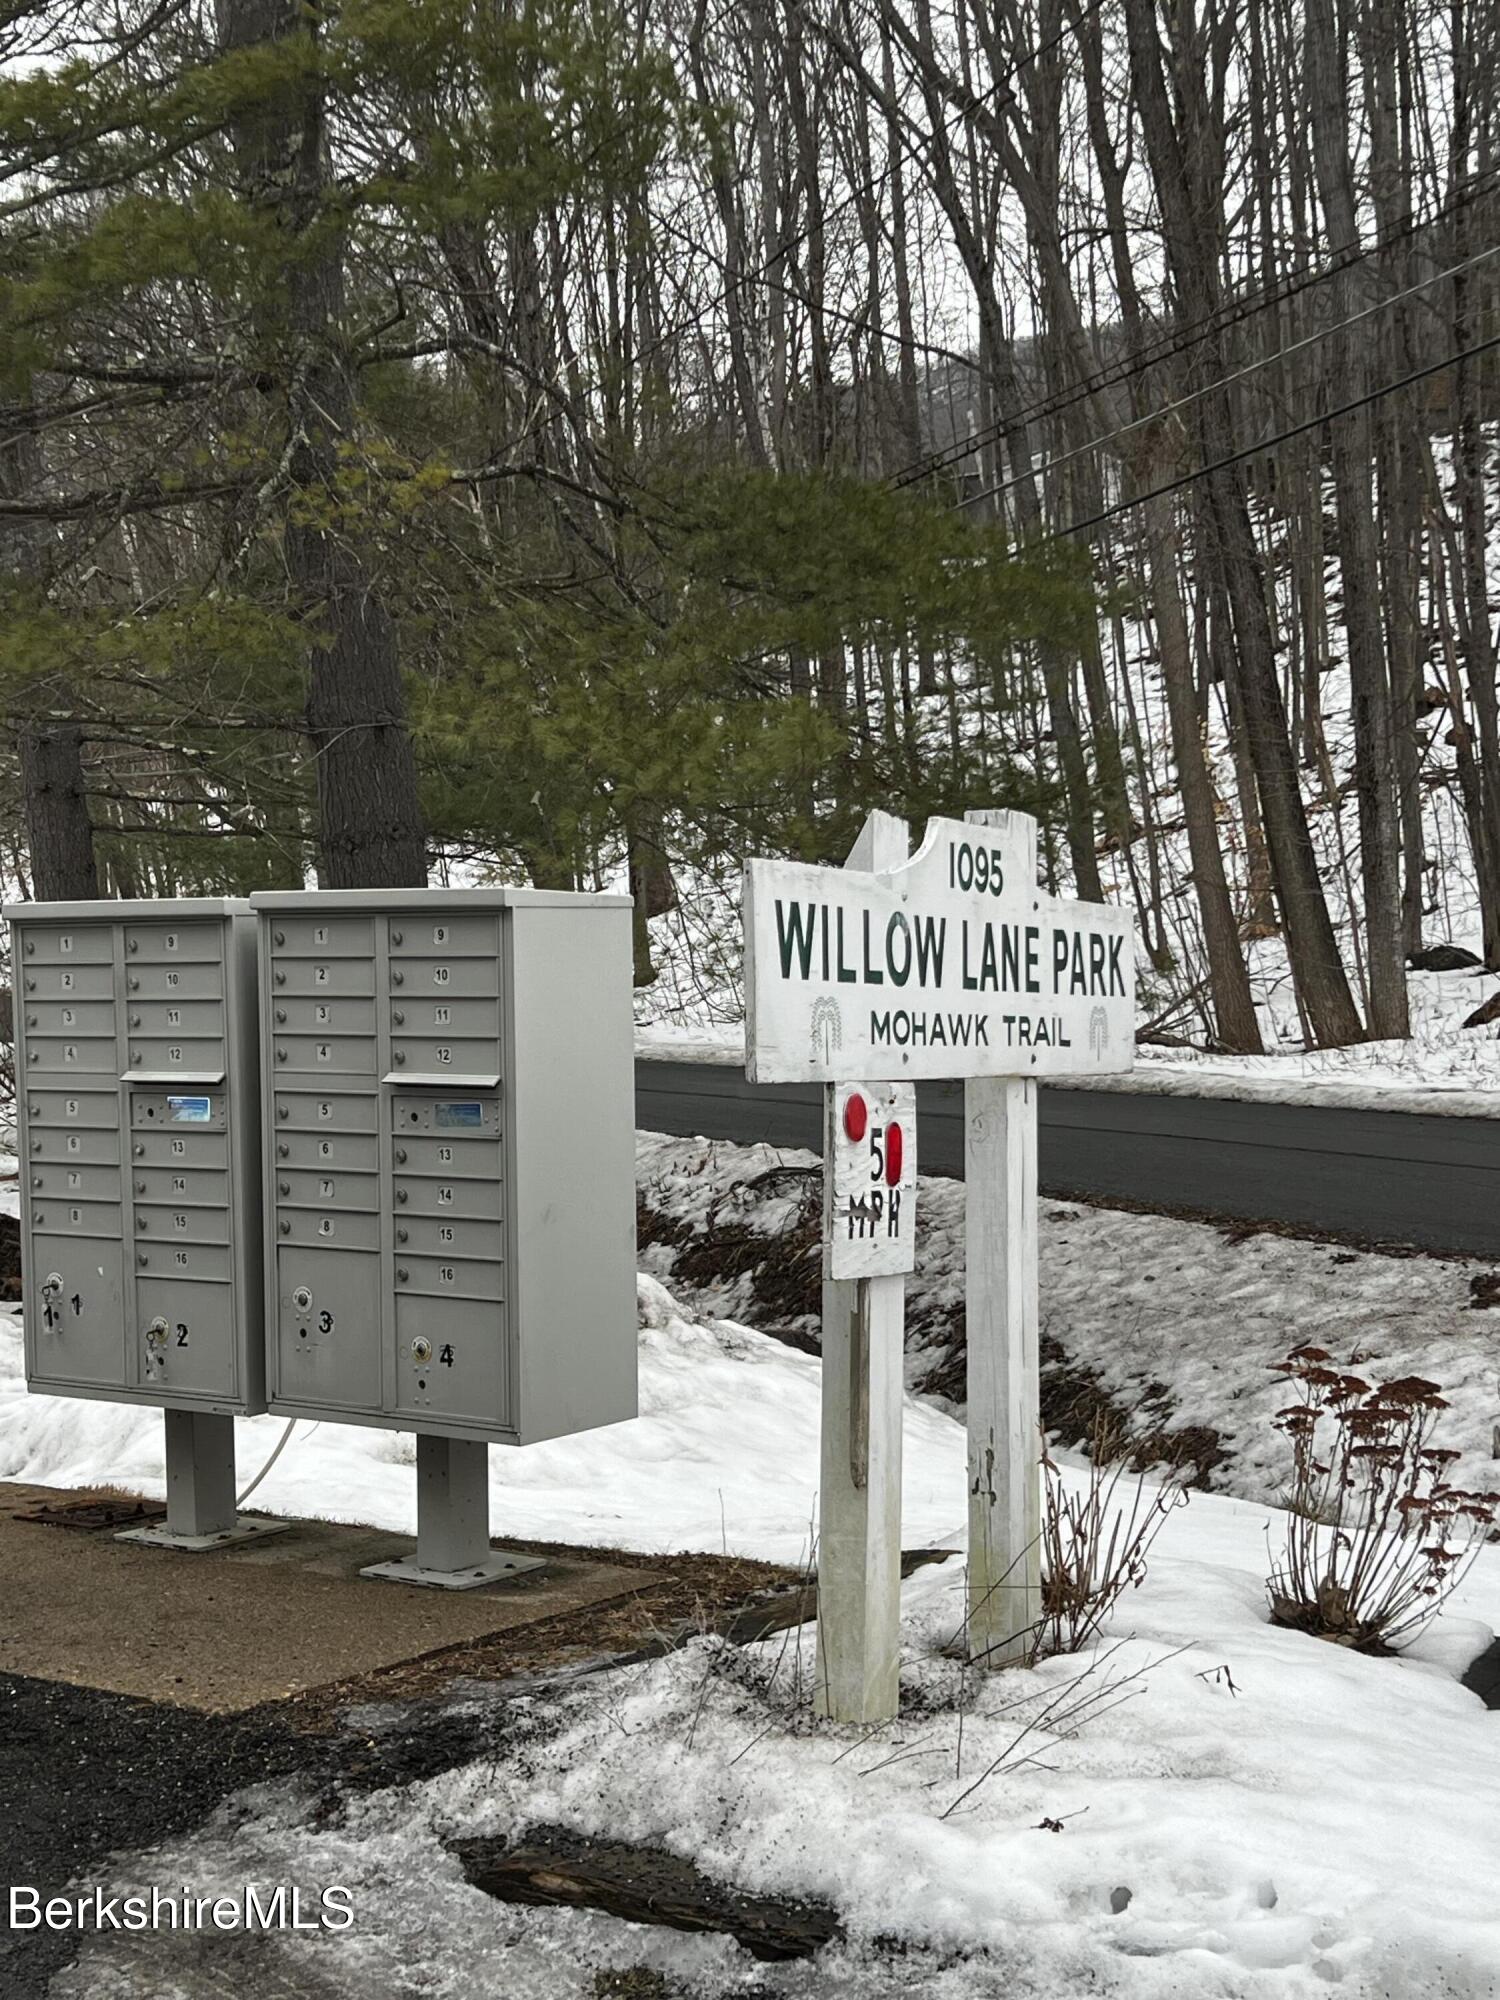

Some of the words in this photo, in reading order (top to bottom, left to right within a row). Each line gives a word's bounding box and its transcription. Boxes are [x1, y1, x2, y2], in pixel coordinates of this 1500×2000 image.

[949, 841, 1003, 897] 1095
[317, 930, 324, 940] 1
[437, 929, 445, 940] 9
[63, 939, 70, 949] 1
[167, 937, 174, 947] 9
[775, 900, 946, 988] WILLOW
[962, 920, 1040, 993] LANE
[1053, 929, 1126, 997] PARK
[64, 975, 71, 985] 2
[168, 974, 178, 985] 10
[318, 969, 326, 980] 2
[436, 969, 447, 980] 10
[65, 1011, 73, 1021] 3
[168, 1012, 179, 1022] 11
[319, 1007, 326, 1018] 3
[438, 1009, 447, 1020] 11
[870, 1010, 989, 1047] MOHAWK
[1003, 1015, 1071, 1047] TRAIL
[67, 1048, 75, 1058] 4
[170, 1049, 180, 1059] 12
[319, 1046, 328, 1057] 4
[438, 1049, 450, 1060] 12
[69, 1102, 76, 1112] 5
[321, 1105, 329, 1115] 5
[70, 1138, 77, 1148] 6
[173, 1142, 183, 1152] 13
[322, 1143, 329, 1154] 6
[440, 1149, 450, 1160] 13
[870, 1127, 883, 1182] 5
[71, 1174, 78, 1184] 7
[174, 1179, 184, 1190] 14
[322, 1182, 330, 1192] 7
[440, 1189, 451, 1200] 14
[72, 1211, 79, 1220] 8
[848, 1190, 901, 1240] MPH
[175, 1216, 186, 1227] 15
[323, 1221, 330, 1232] 8
[441, 1229, 452, 1240] 15
[176, 1253, 187, 1265] 16
[442, 1269, 453, 1280] 16
[71, 1293, 80, 1316] 1
[318, 1310, 332, 1334] 3
[176, 1323, 188, 1347] 2
[439, 1343, 454, 1368] 4
